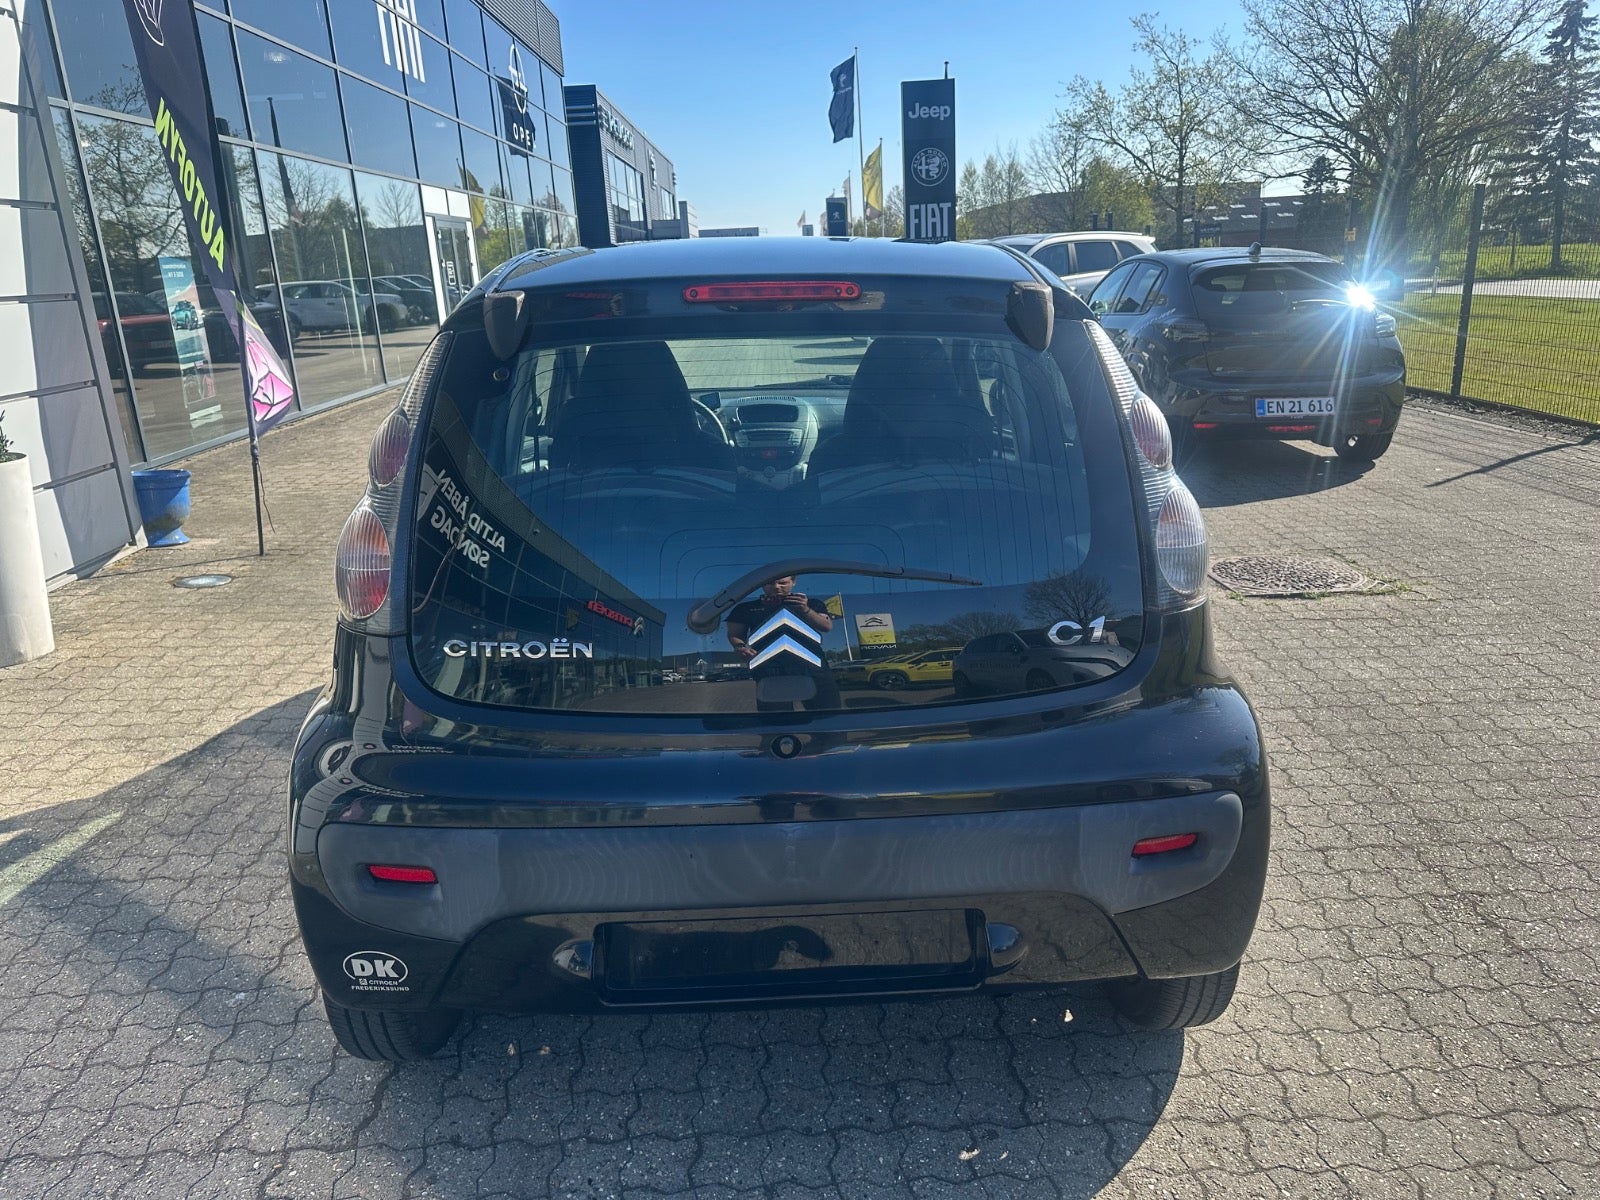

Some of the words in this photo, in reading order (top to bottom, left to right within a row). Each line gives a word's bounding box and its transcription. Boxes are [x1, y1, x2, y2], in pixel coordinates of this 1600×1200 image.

[908, 102, 951, 121] Jeep
[909, 202, 952, 240] FIAT
[1266, 400, 1285, 414] EN
[1288, 400, 1304, 413] 21
[1308, 399, 1334, 413] 616
[1047, 615, 1106, 646] C1
[443, 637, 594, 660] CITROËN
[350, 958, 400, 978] DK
